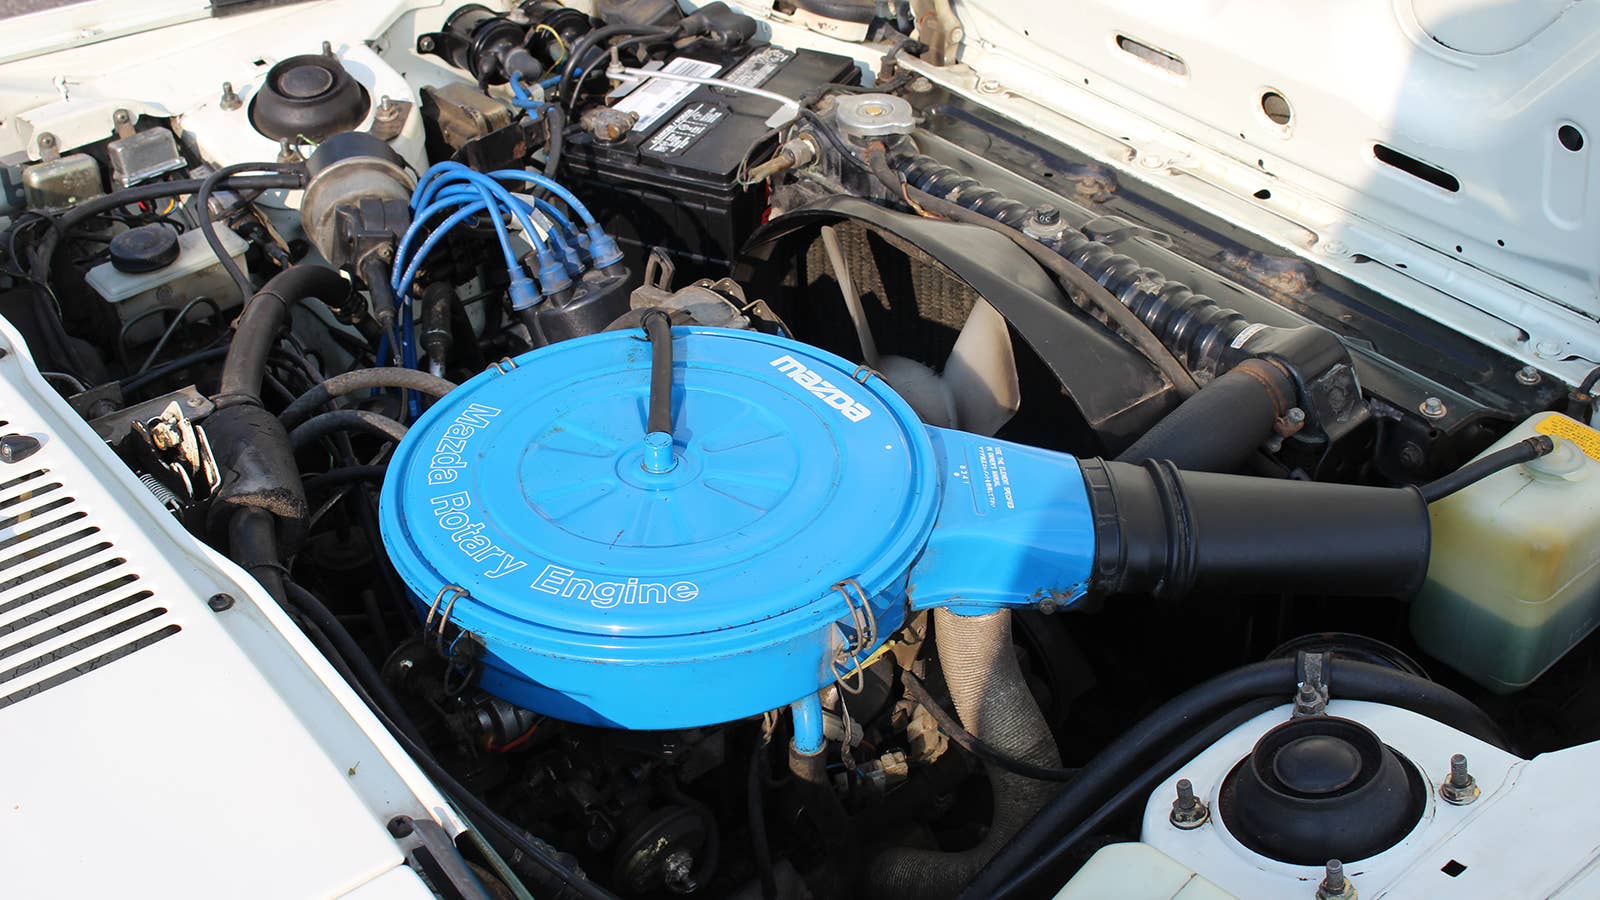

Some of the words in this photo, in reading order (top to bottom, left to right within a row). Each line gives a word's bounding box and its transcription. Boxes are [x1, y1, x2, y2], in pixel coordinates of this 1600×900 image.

[428, 403, 502, 486] Mazda
[431, 490, 528, 579] Rotary
[530, 564, 699, 609] Engine
